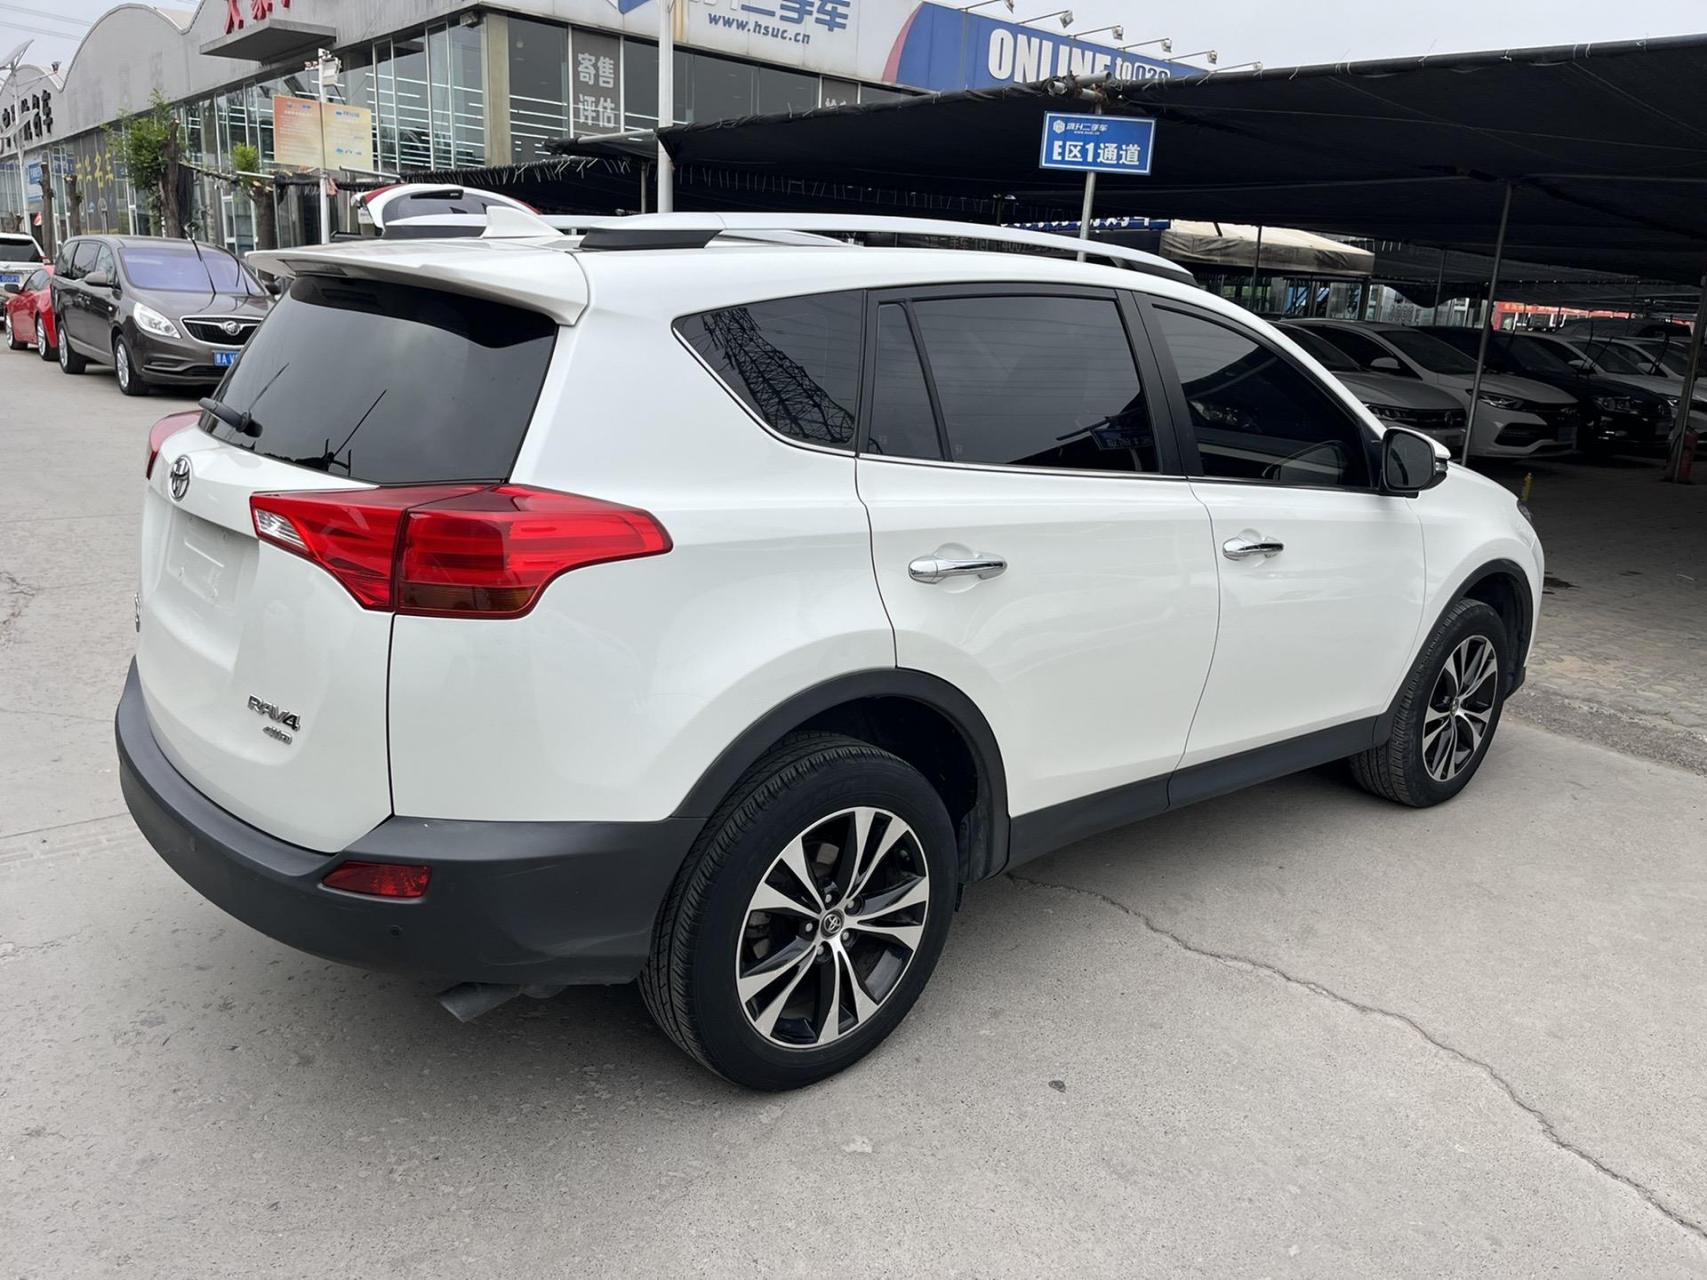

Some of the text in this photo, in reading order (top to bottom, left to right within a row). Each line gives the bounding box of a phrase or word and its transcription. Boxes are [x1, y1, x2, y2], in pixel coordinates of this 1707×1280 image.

[708, 13, 811, 45] www.hsuc.cn
[577, 52, 615, 88] 寄售
[578, 93, 615, 128] 评估
[1052, 140, 1141, 165] E区1通道
[248, 694, 301, 732] RAV4
